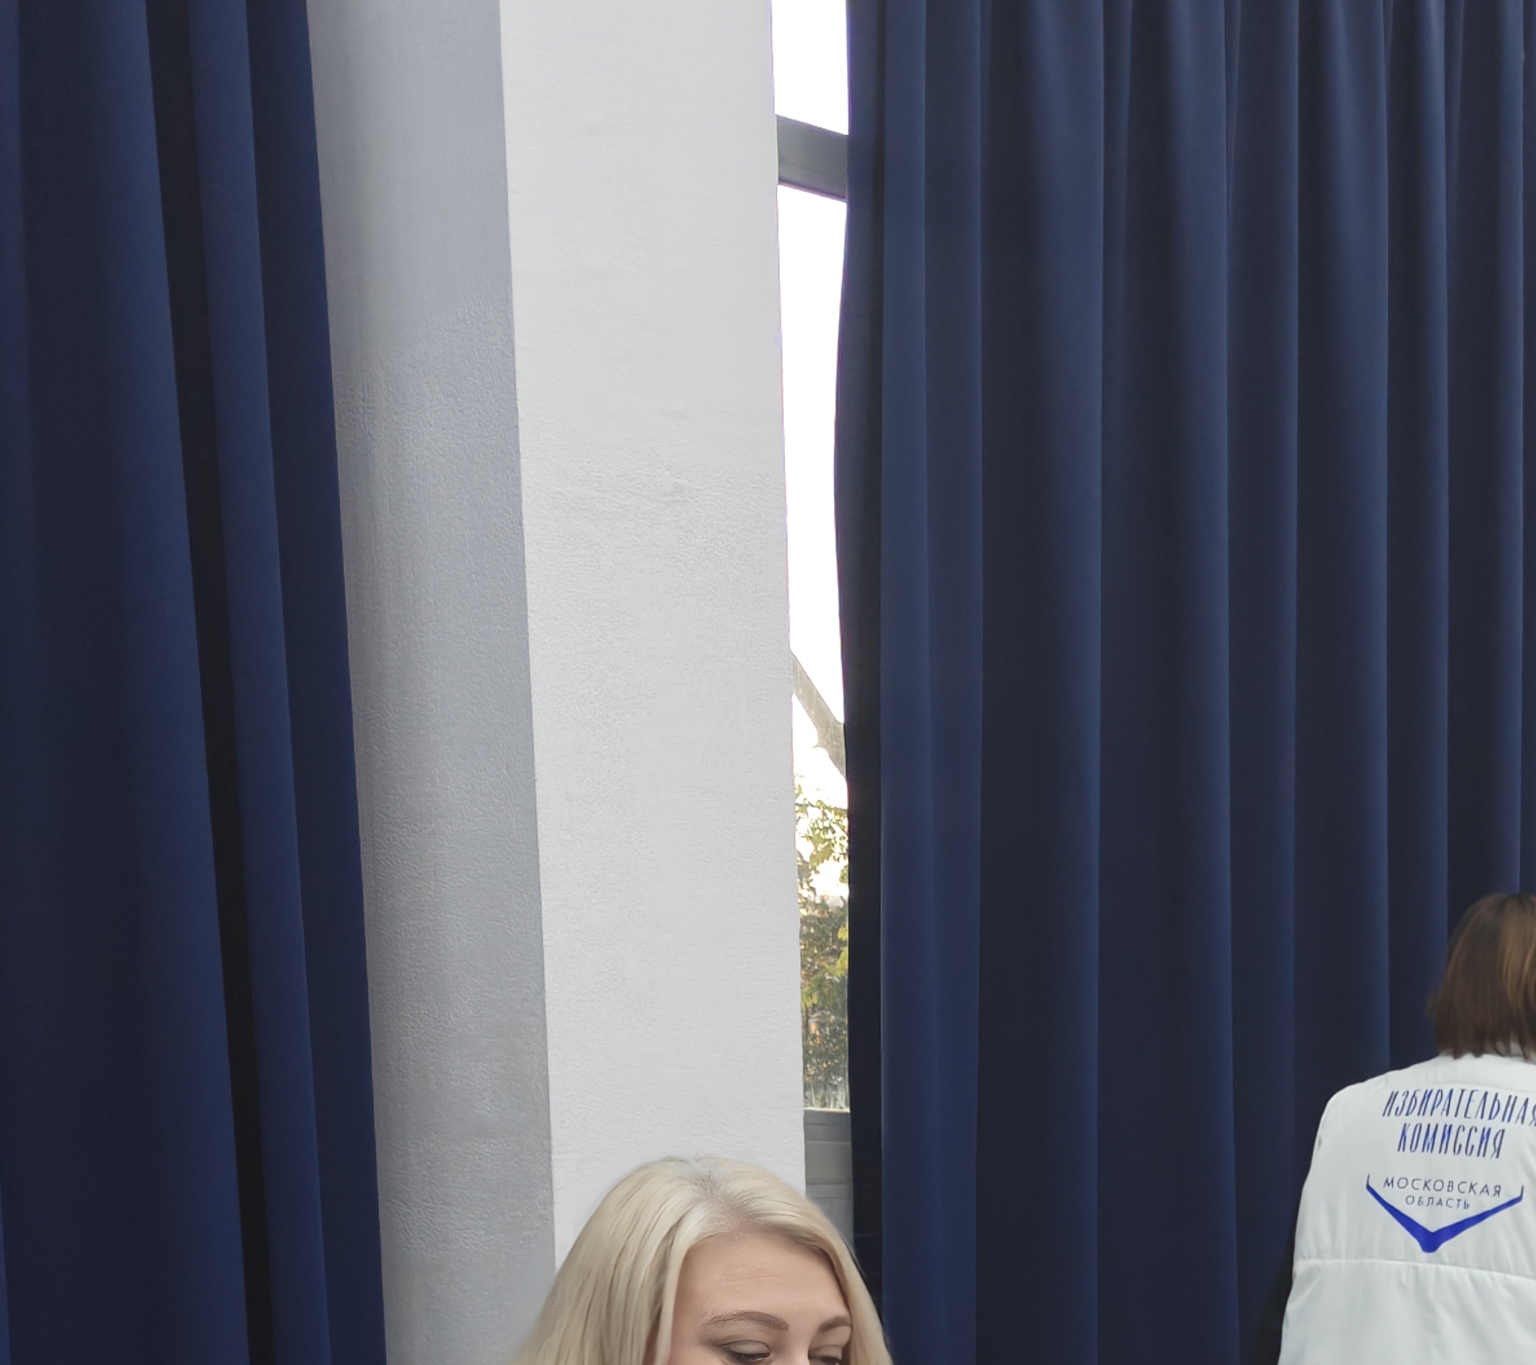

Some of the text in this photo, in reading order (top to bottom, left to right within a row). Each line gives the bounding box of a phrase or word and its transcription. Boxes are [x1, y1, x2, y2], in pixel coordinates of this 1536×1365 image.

[1397, 1122, 1505, 1159] КОМИССИЯ
[1383, 1176, 1502, 1198] МОСКОВСКАЯ
[1405, 1195, 1470, 1210] ОБЛАСТЬ
